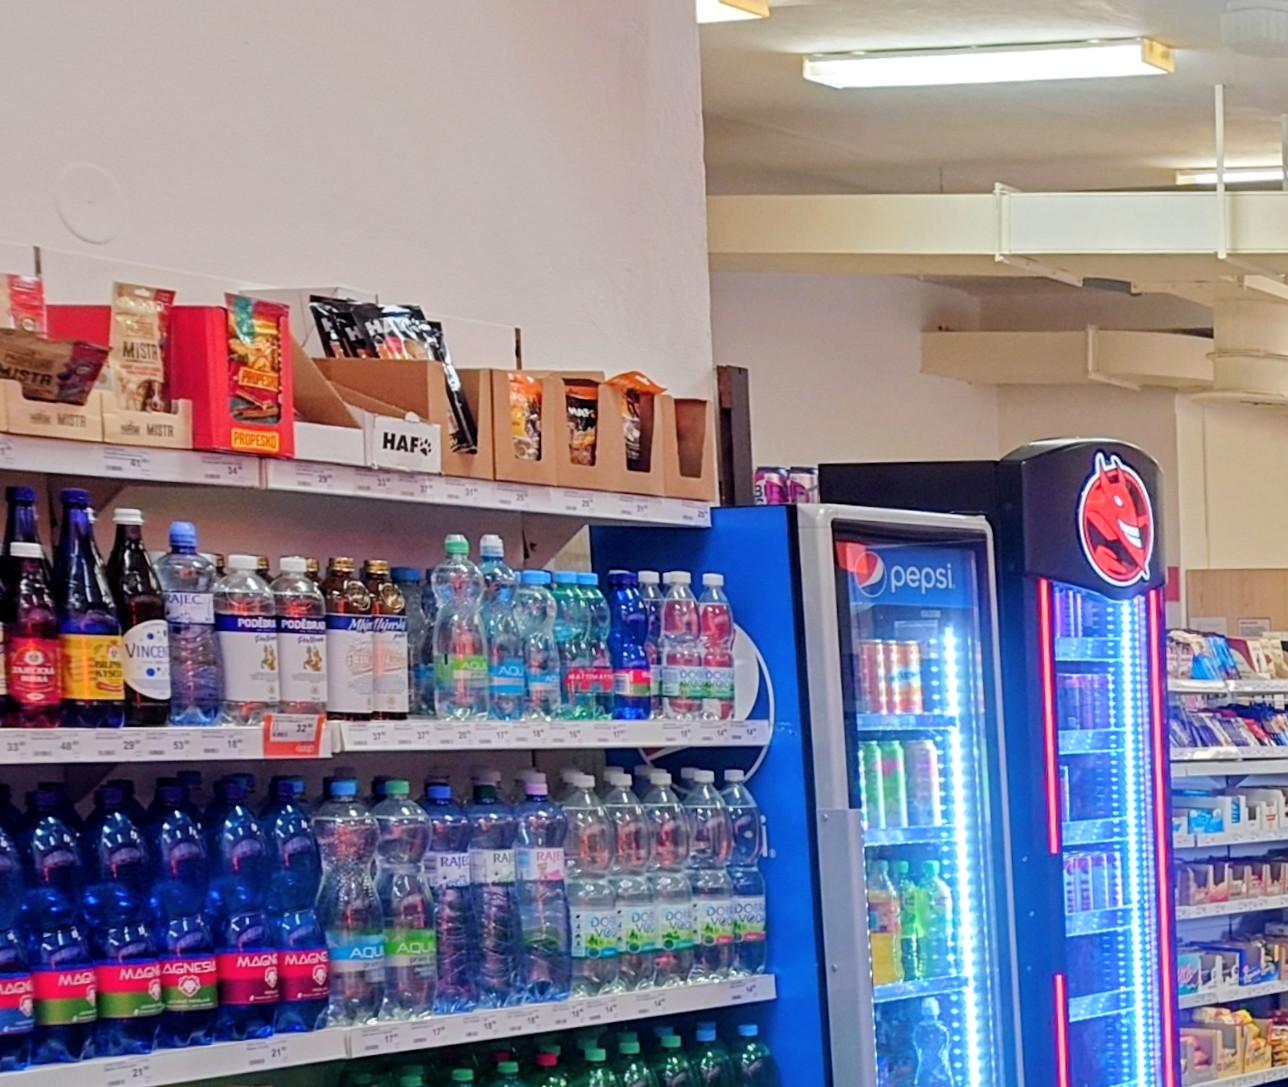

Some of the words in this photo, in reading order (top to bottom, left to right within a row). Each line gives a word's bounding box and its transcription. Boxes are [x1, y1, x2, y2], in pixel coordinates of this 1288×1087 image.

[123, 340, 158, 360] MISTR
[233, 430, 279, 450] PROPESKO
[383, 431, 420, 454] HAF
[890, 562, 955, 595] pepsi
